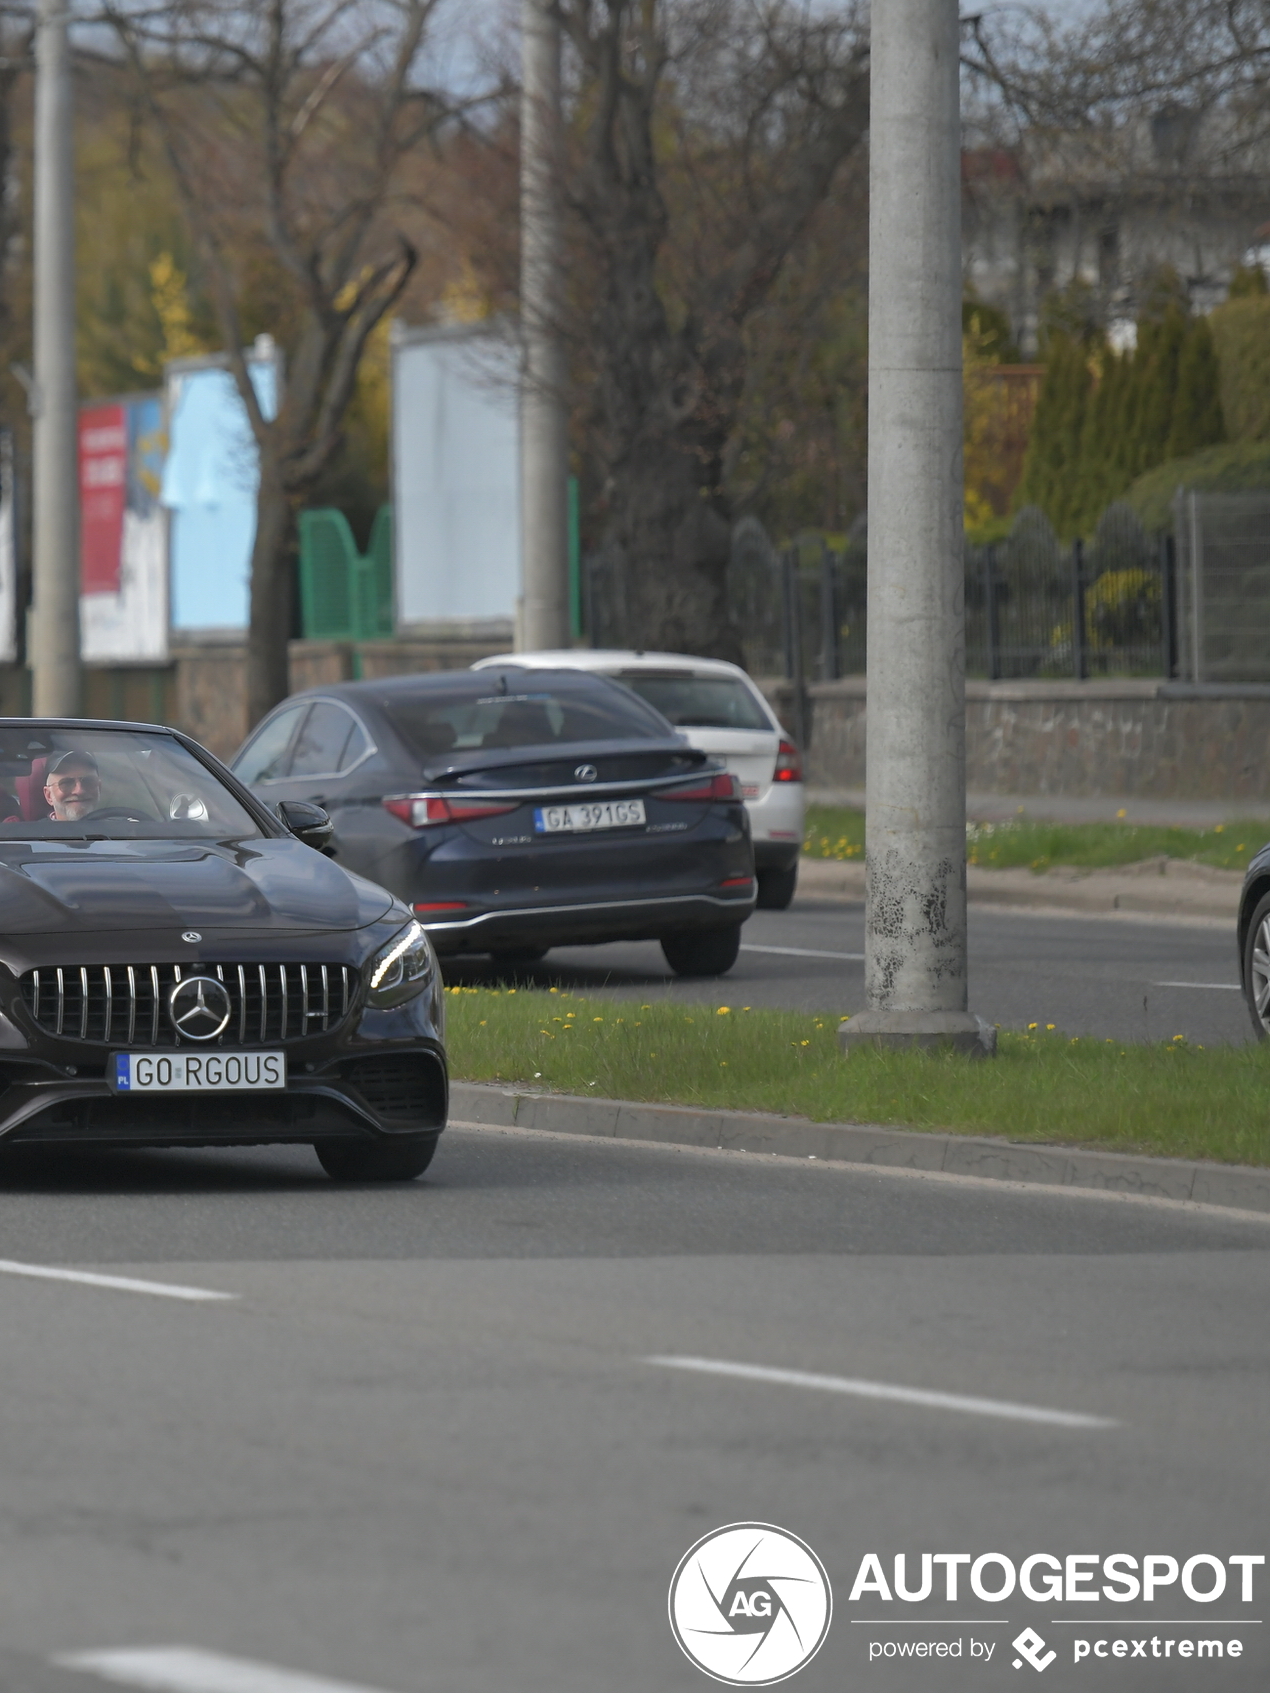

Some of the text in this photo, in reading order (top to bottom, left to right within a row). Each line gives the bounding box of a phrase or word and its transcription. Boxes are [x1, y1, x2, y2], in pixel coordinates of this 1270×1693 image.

[547, 802, 641, 829] GA 391GS
[117, 1075, 129, 1085] PL
[136, 1055, 280, 1086] GO RGOUS
